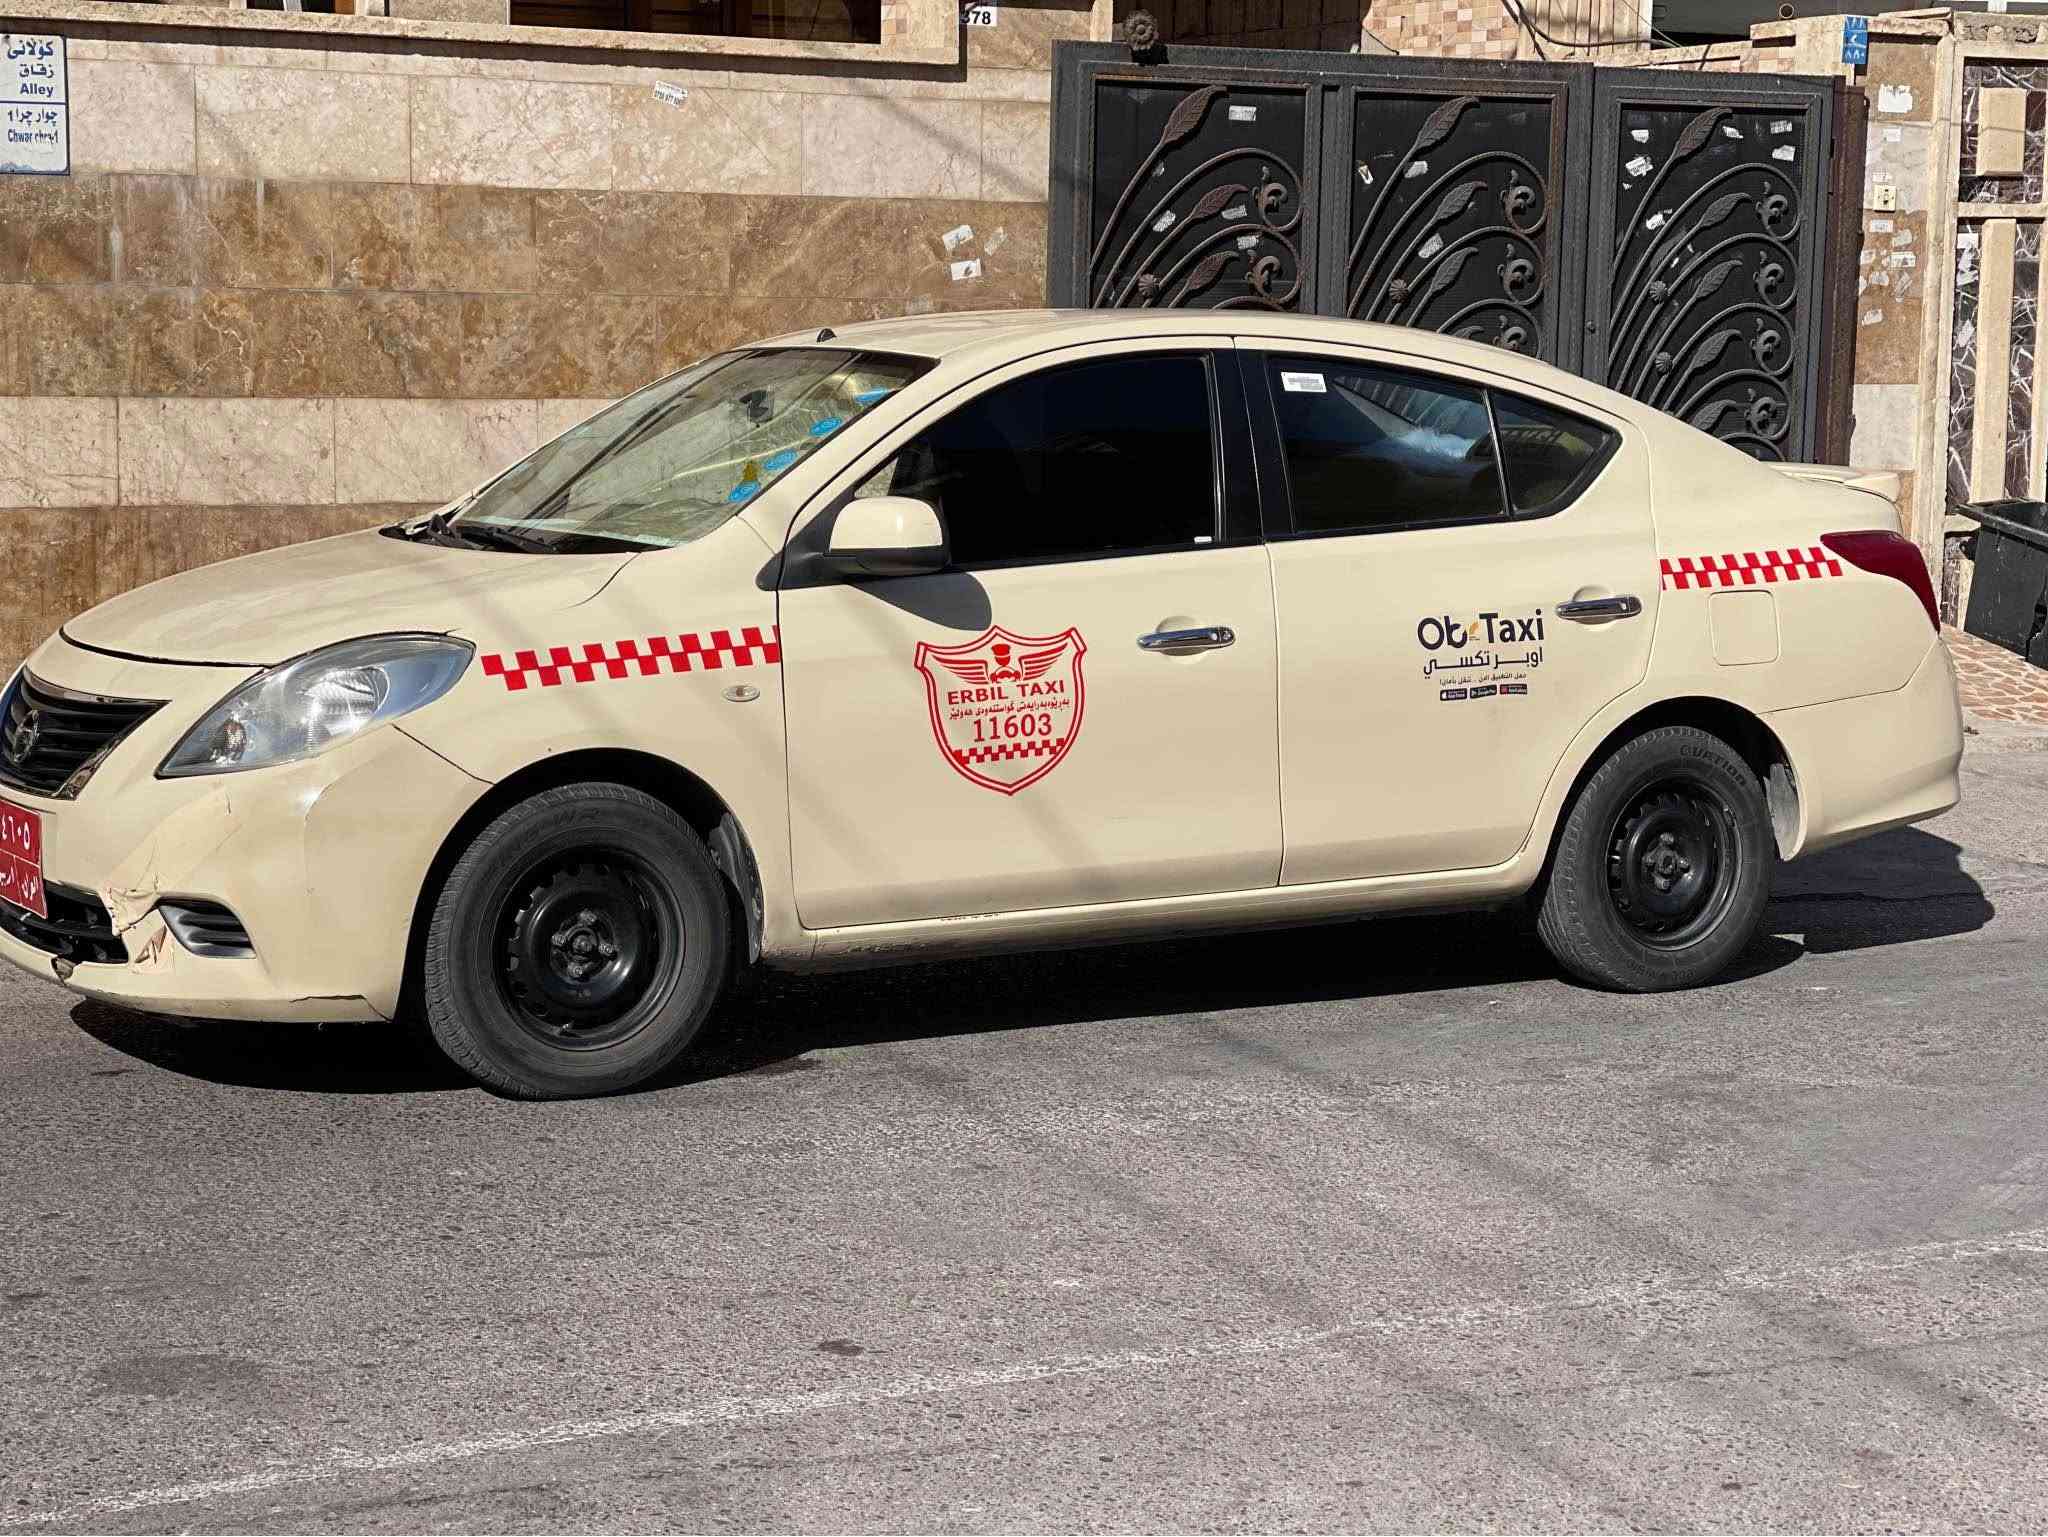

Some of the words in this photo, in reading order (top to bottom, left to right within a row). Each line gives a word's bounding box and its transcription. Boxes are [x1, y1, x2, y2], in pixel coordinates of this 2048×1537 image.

[19, 63, 54, 78] زقاق
[20, 82, 54, 98] Alley
[7, 128, 33, 143] Chwar
[947, 686, 1009, 705] ERBIL
[1016, 679, 1065, 698] TAXI
[973, 713, 1052, 743] 11603
